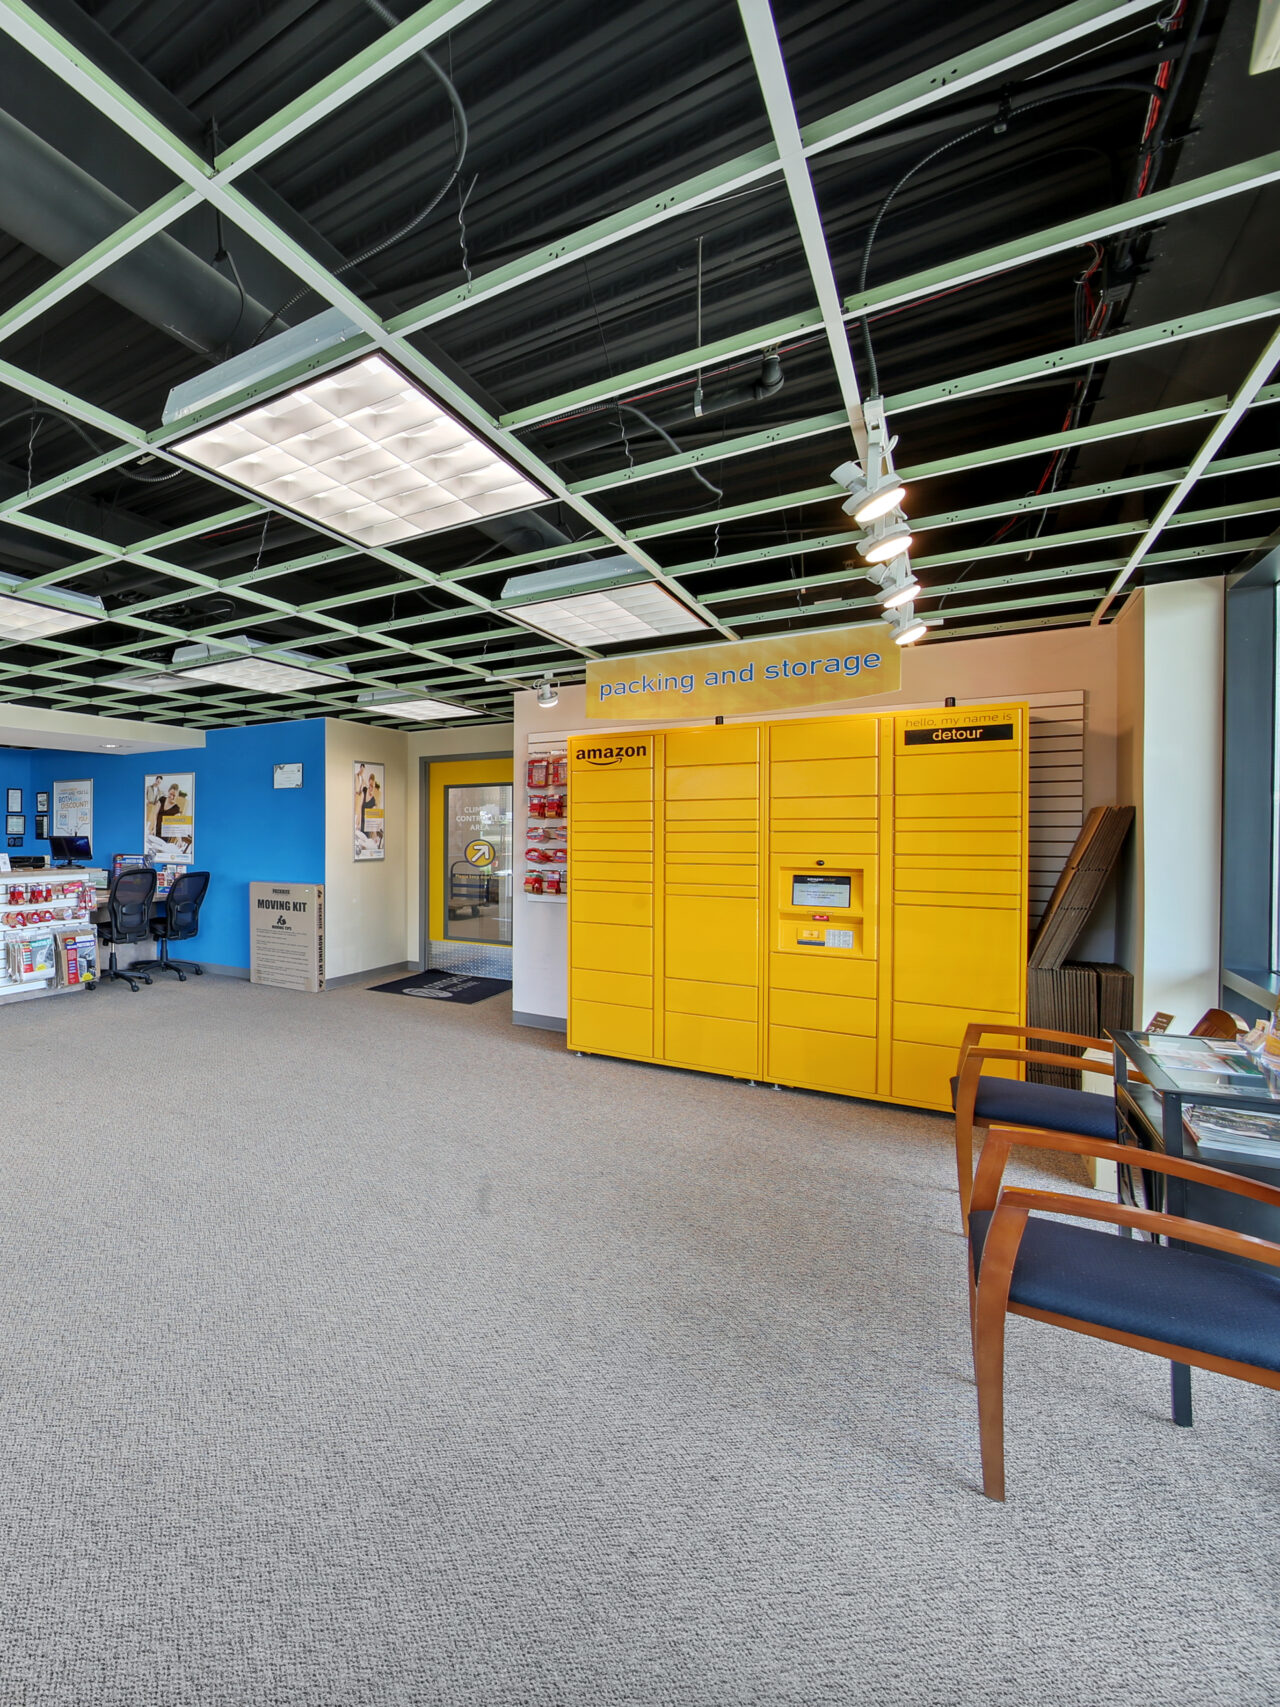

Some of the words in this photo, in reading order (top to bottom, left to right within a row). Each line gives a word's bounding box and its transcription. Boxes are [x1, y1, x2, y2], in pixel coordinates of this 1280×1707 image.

[600, 673, 695, 701] packing
[704, 662, 755, 687] and
[764, 652, 881, 680] storage
[905, 718, 937, 728] hello,
[941, 716, 960, 726] my
[963, 713, 999, 724] name
[1003, 712, 1013, 721] is
[932, 728, 983, 741] detour
[575, 744, 647, 763] amazon
[257, 899, 291, 912] MOVING
[293, 901, 308, 913] KIT
